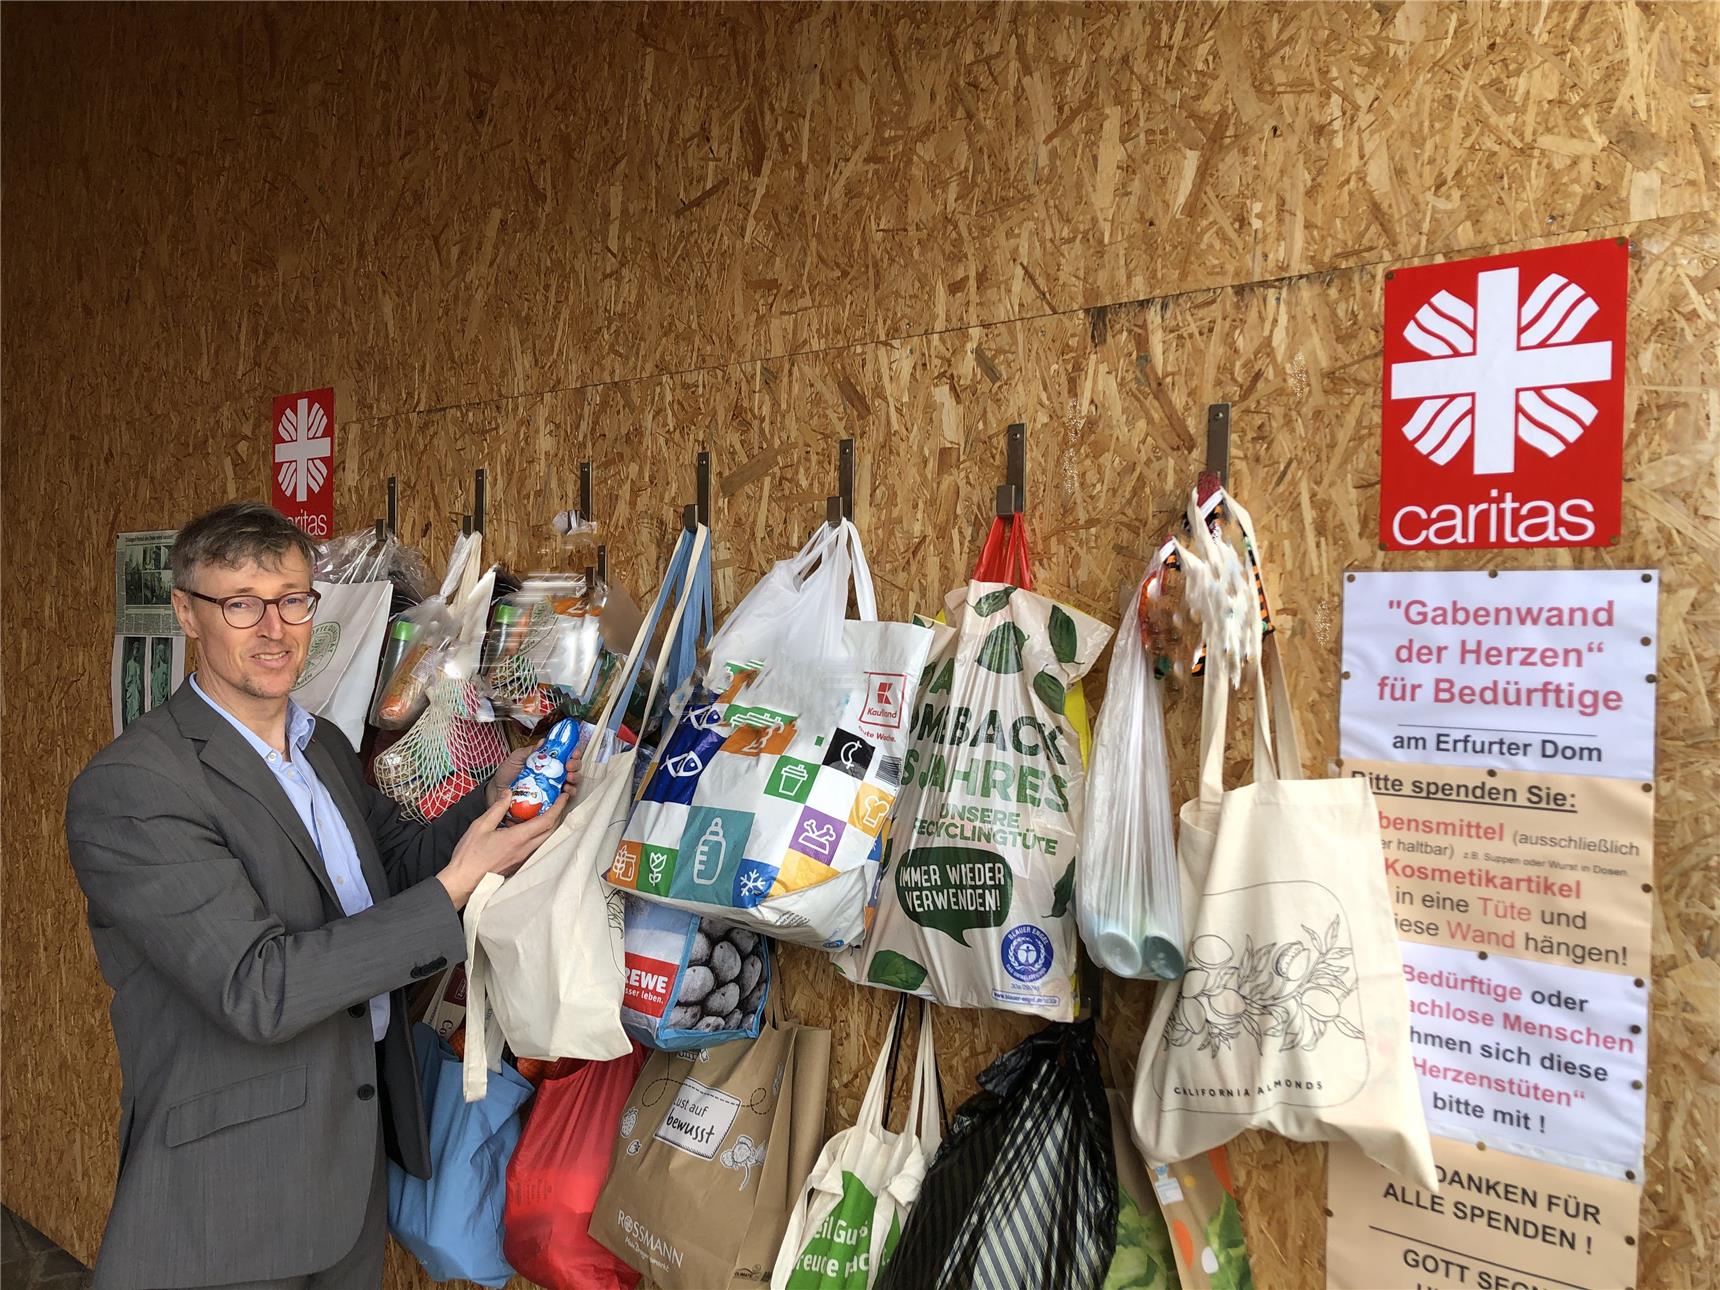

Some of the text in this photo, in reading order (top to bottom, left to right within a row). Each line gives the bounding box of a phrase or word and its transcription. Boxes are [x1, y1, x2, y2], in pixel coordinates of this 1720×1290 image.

[287, 509, 327, 536] aritas
[1392, 488, 1596, 545] caritas
[1388, 599, 1615, 627] "Gabenwand
[1395, 639, 1448, 664] der
[1378, 676, 1624, 716] für Bedürftige
[1393, 733, 1602, 763] am Erfurter Dom
[1411, 779, 1517, 803] spenden
[1527, 785, 1577, 809] Sie:
[940, 803, 1020, 829] UNSERE
[1378, 811, 1640, 856] bensmittel (ausschließlich
[1397, 838, 1455, 860] haltbar)
[1484, 852, 1521, 865] Suppen
[1523, 857, 1545, 868] oder
[1549, 860, 1578, 871] Wurst
[1581, 864, 1590, 873] in
[900, 863, 1005, 888] IMMER WIEDER
[1385, 857, 1581, 900] Kosmetikartikel
[905, 888, 1000, 912] VERWENDEN!
[1396, 886, 1587, 930] in eine Tüte und
[1007, 926, 1031, 940] BLAUER
[1394, 913, 1628, 966] iese Wand hängen!
[625, 988, 664, 1005] sser leben.
[1402, 964, 1588, 1013] Bedürftige oder
[1503, 1011, 1635, 1053] Menschen
[1410, 1025, 1608, 1082] hmen sich diese
[1174, 1079, 1324, 1098] CALIFORNIA ALMONDS
[666, 1108, 715, 1144] bewusst
[689, 1102, 709, 1118] auf
[1433, 1091, 1484, 1119] bitte
[1493, 1108, 1531, 1131] mit
[1435, 1164, 1602, 1225] DANKEN FÜR
[1383, 1182, 1445, 1215] ALLE
[1452, 1200, 1576, 1251] SPENDEN
[617, 1209, 684, 1269] ROSSMANN
[1403, 1248, 1470, 1283] GOTT
